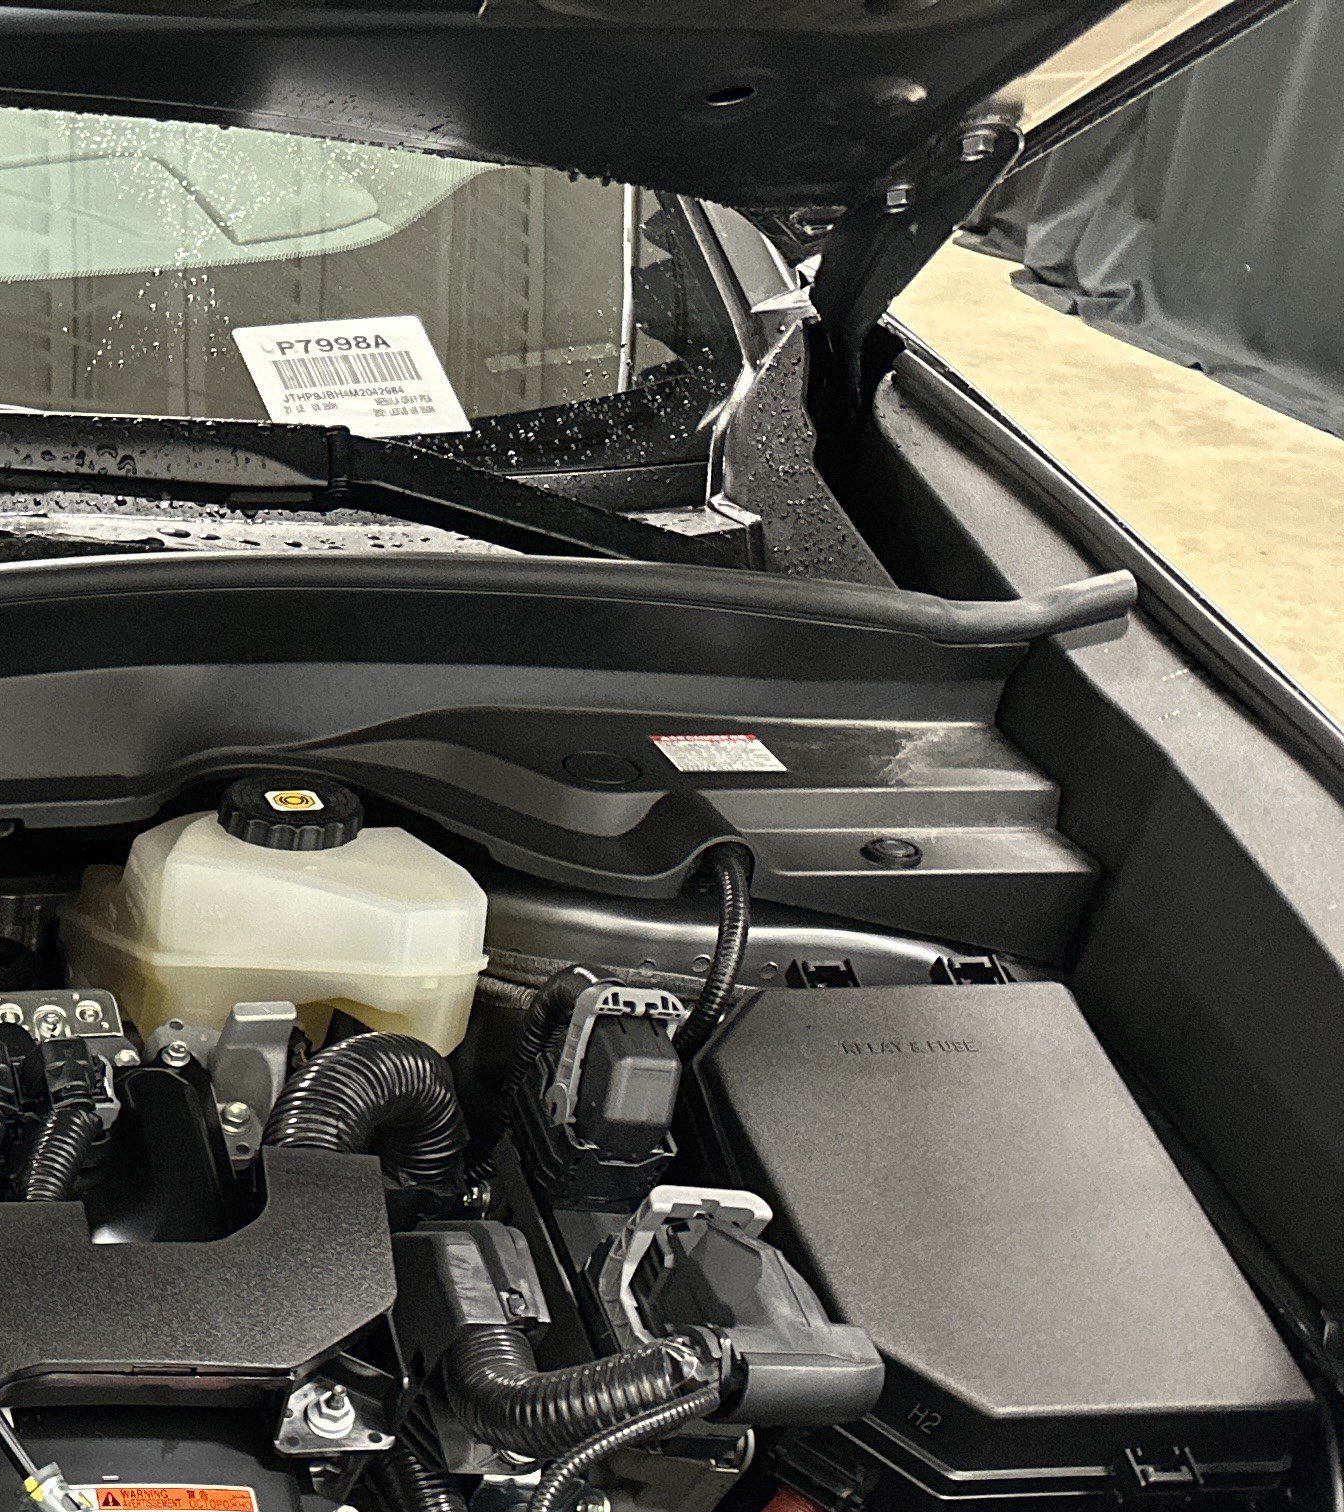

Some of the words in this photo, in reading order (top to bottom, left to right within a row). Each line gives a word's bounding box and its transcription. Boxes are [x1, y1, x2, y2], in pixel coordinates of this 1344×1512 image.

[275, 334, 392, 356] P7998A
[907, 1402, 943, 1435] H2
[120, 1489, 169, 1499] WARNING
